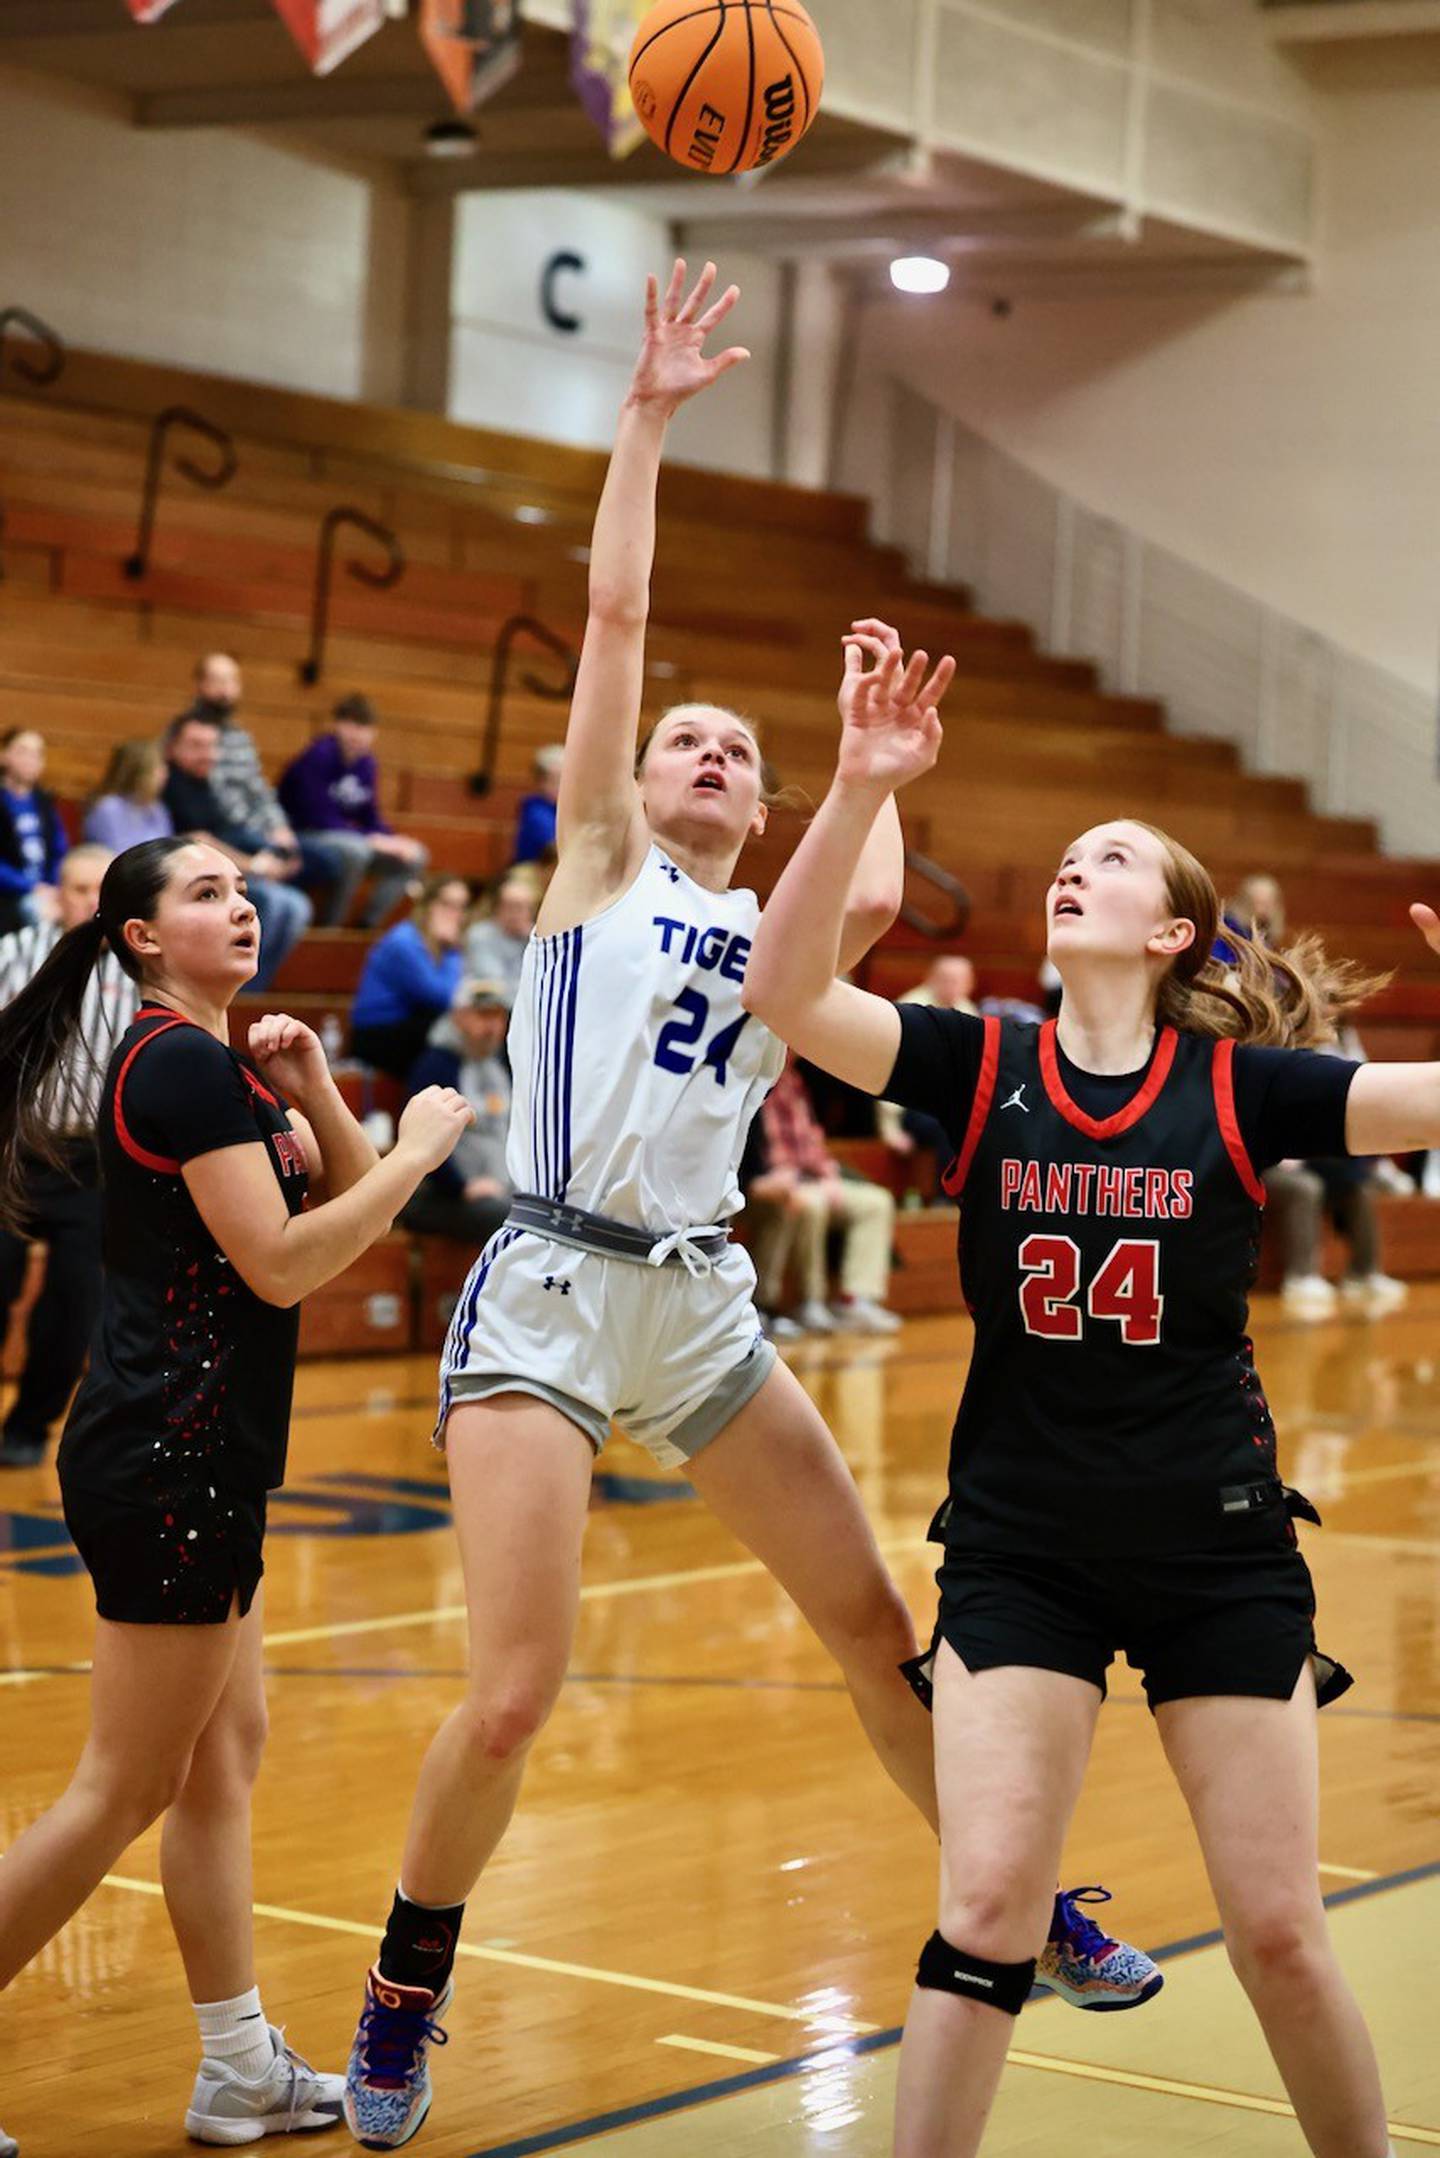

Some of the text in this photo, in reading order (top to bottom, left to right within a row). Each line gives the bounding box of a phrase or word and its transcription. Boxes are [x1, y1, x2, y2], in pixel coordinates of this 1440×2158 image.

[751, 72, 796, 169] Wils
[540, 252, 584, 333] C
[652, 916, 753, 984] TIGE
[1001, 1158, 1194, 1220] PANTHERS
[1018, 1233, 1165, 1345] 24
